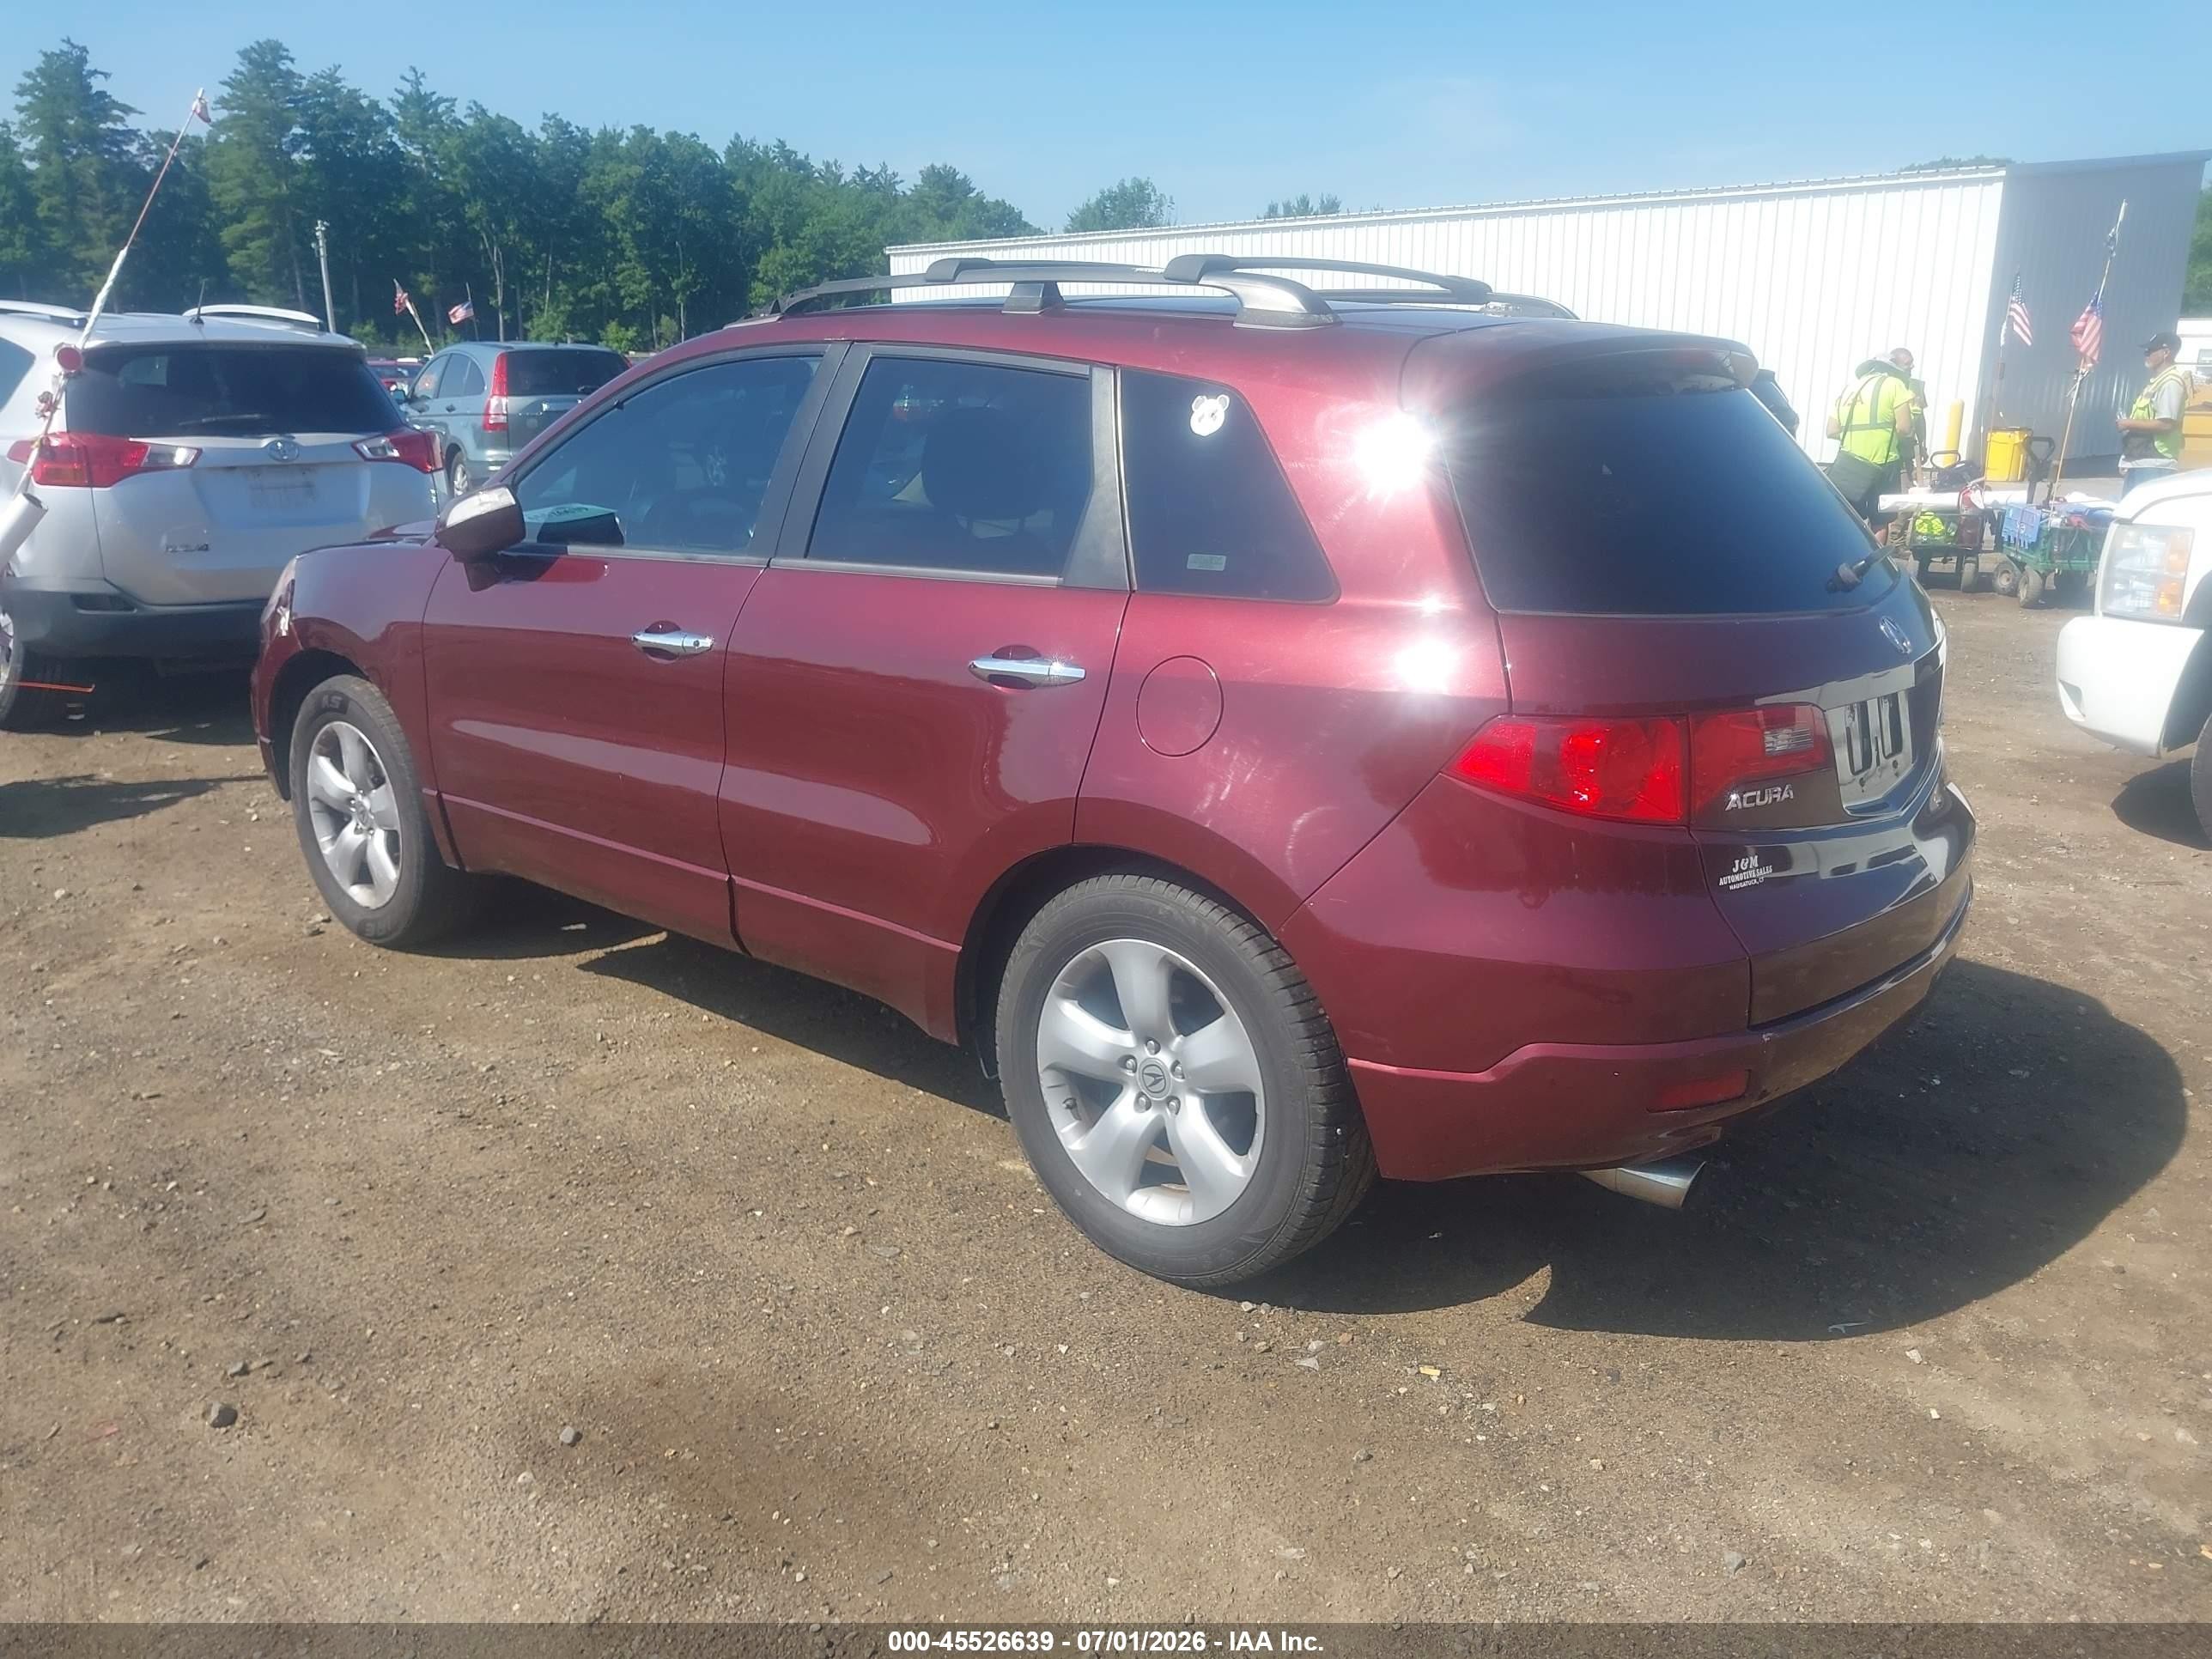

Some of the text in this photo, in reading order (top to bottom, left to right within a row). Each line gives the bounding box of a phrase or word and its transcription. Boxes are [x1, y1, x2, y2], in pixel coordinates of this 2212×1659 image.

[1724, 783, 1794, 811] ACURA
[1732, 854, 1759, 872] J&M
[1719, 865, 1773, 886] AUTOMOTIVE SALES
